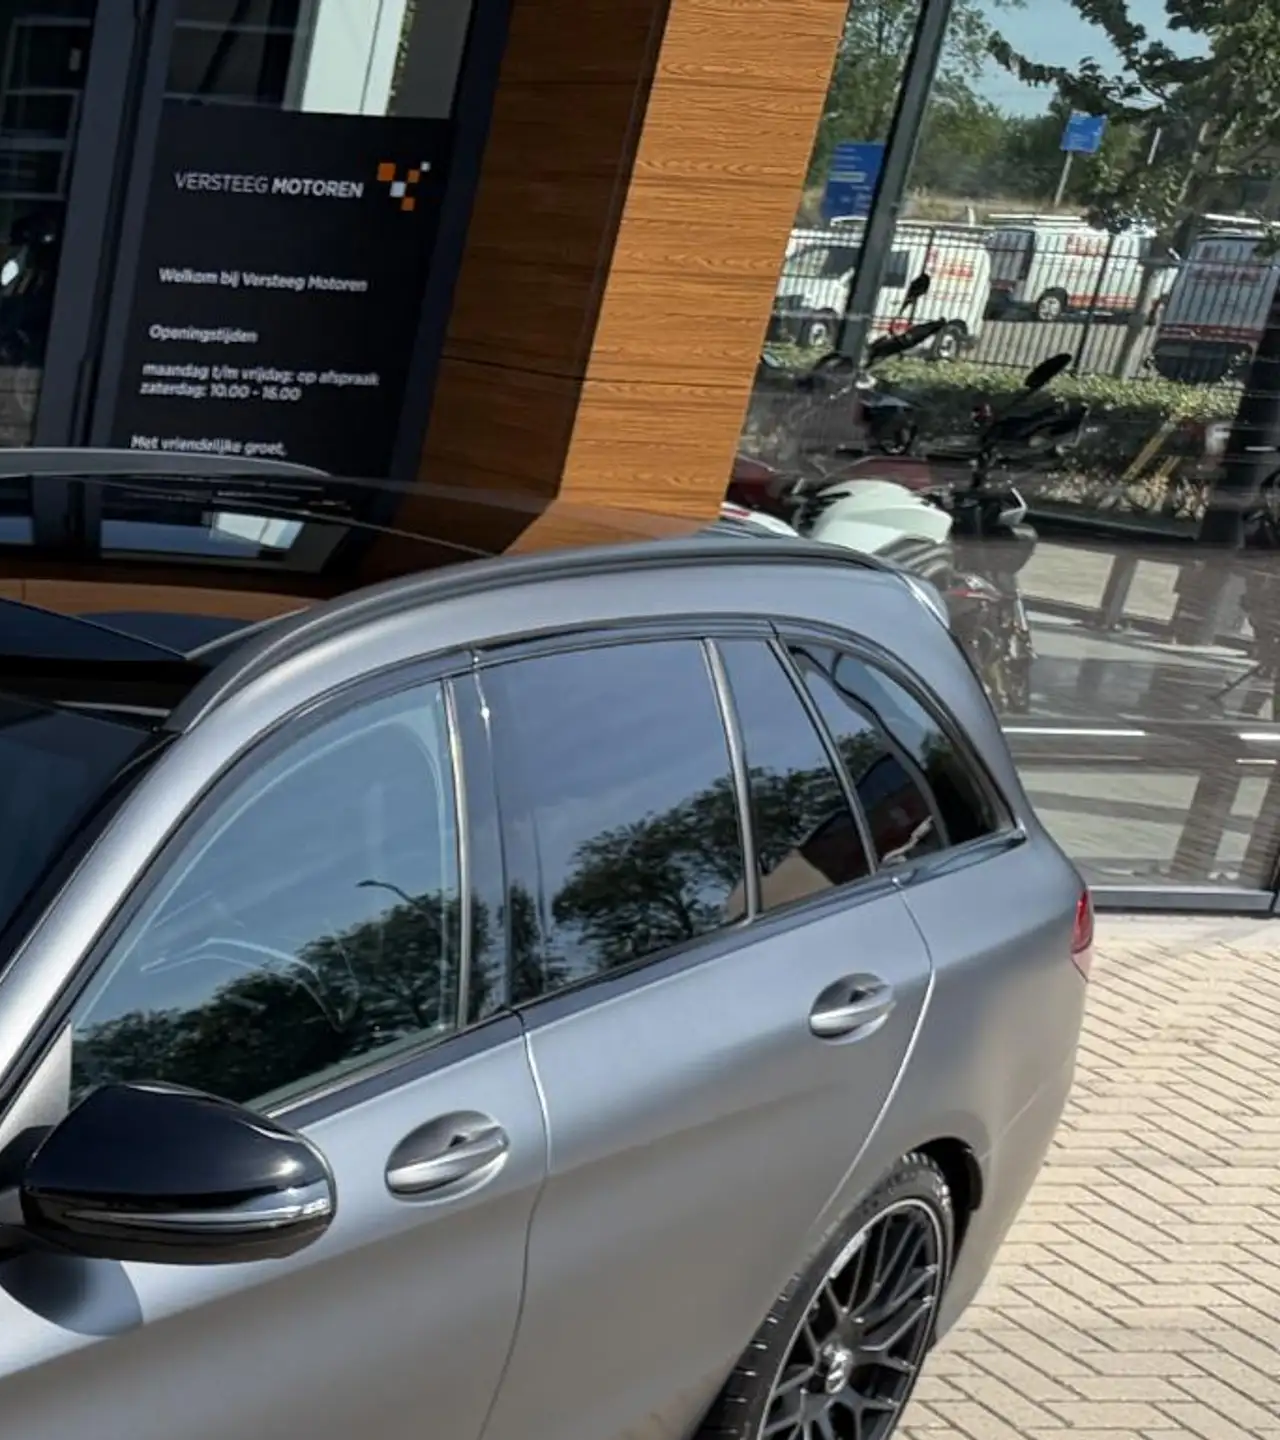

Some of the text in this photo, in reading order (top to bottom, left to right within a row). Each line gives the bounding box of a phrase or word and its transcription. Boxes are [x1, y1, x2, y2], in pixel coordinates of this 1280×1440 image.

[175, 171, 365, 199] VERSTEEG MOTOREN
[159, 267, 369, 292] Welkom bij Versteeg Motoren
[148, 323, 259, 344] Openingstijden
[142, 363, 380, 387] maandag t/m vrijdag: op afspraak
[140, 381, 207, 399] zaterdag:
[210, 383, 250, 399] 10.00
[262, 386, 303, 401] 16.00
[130, 434, 287, 457] Met vriendelijke groet,
